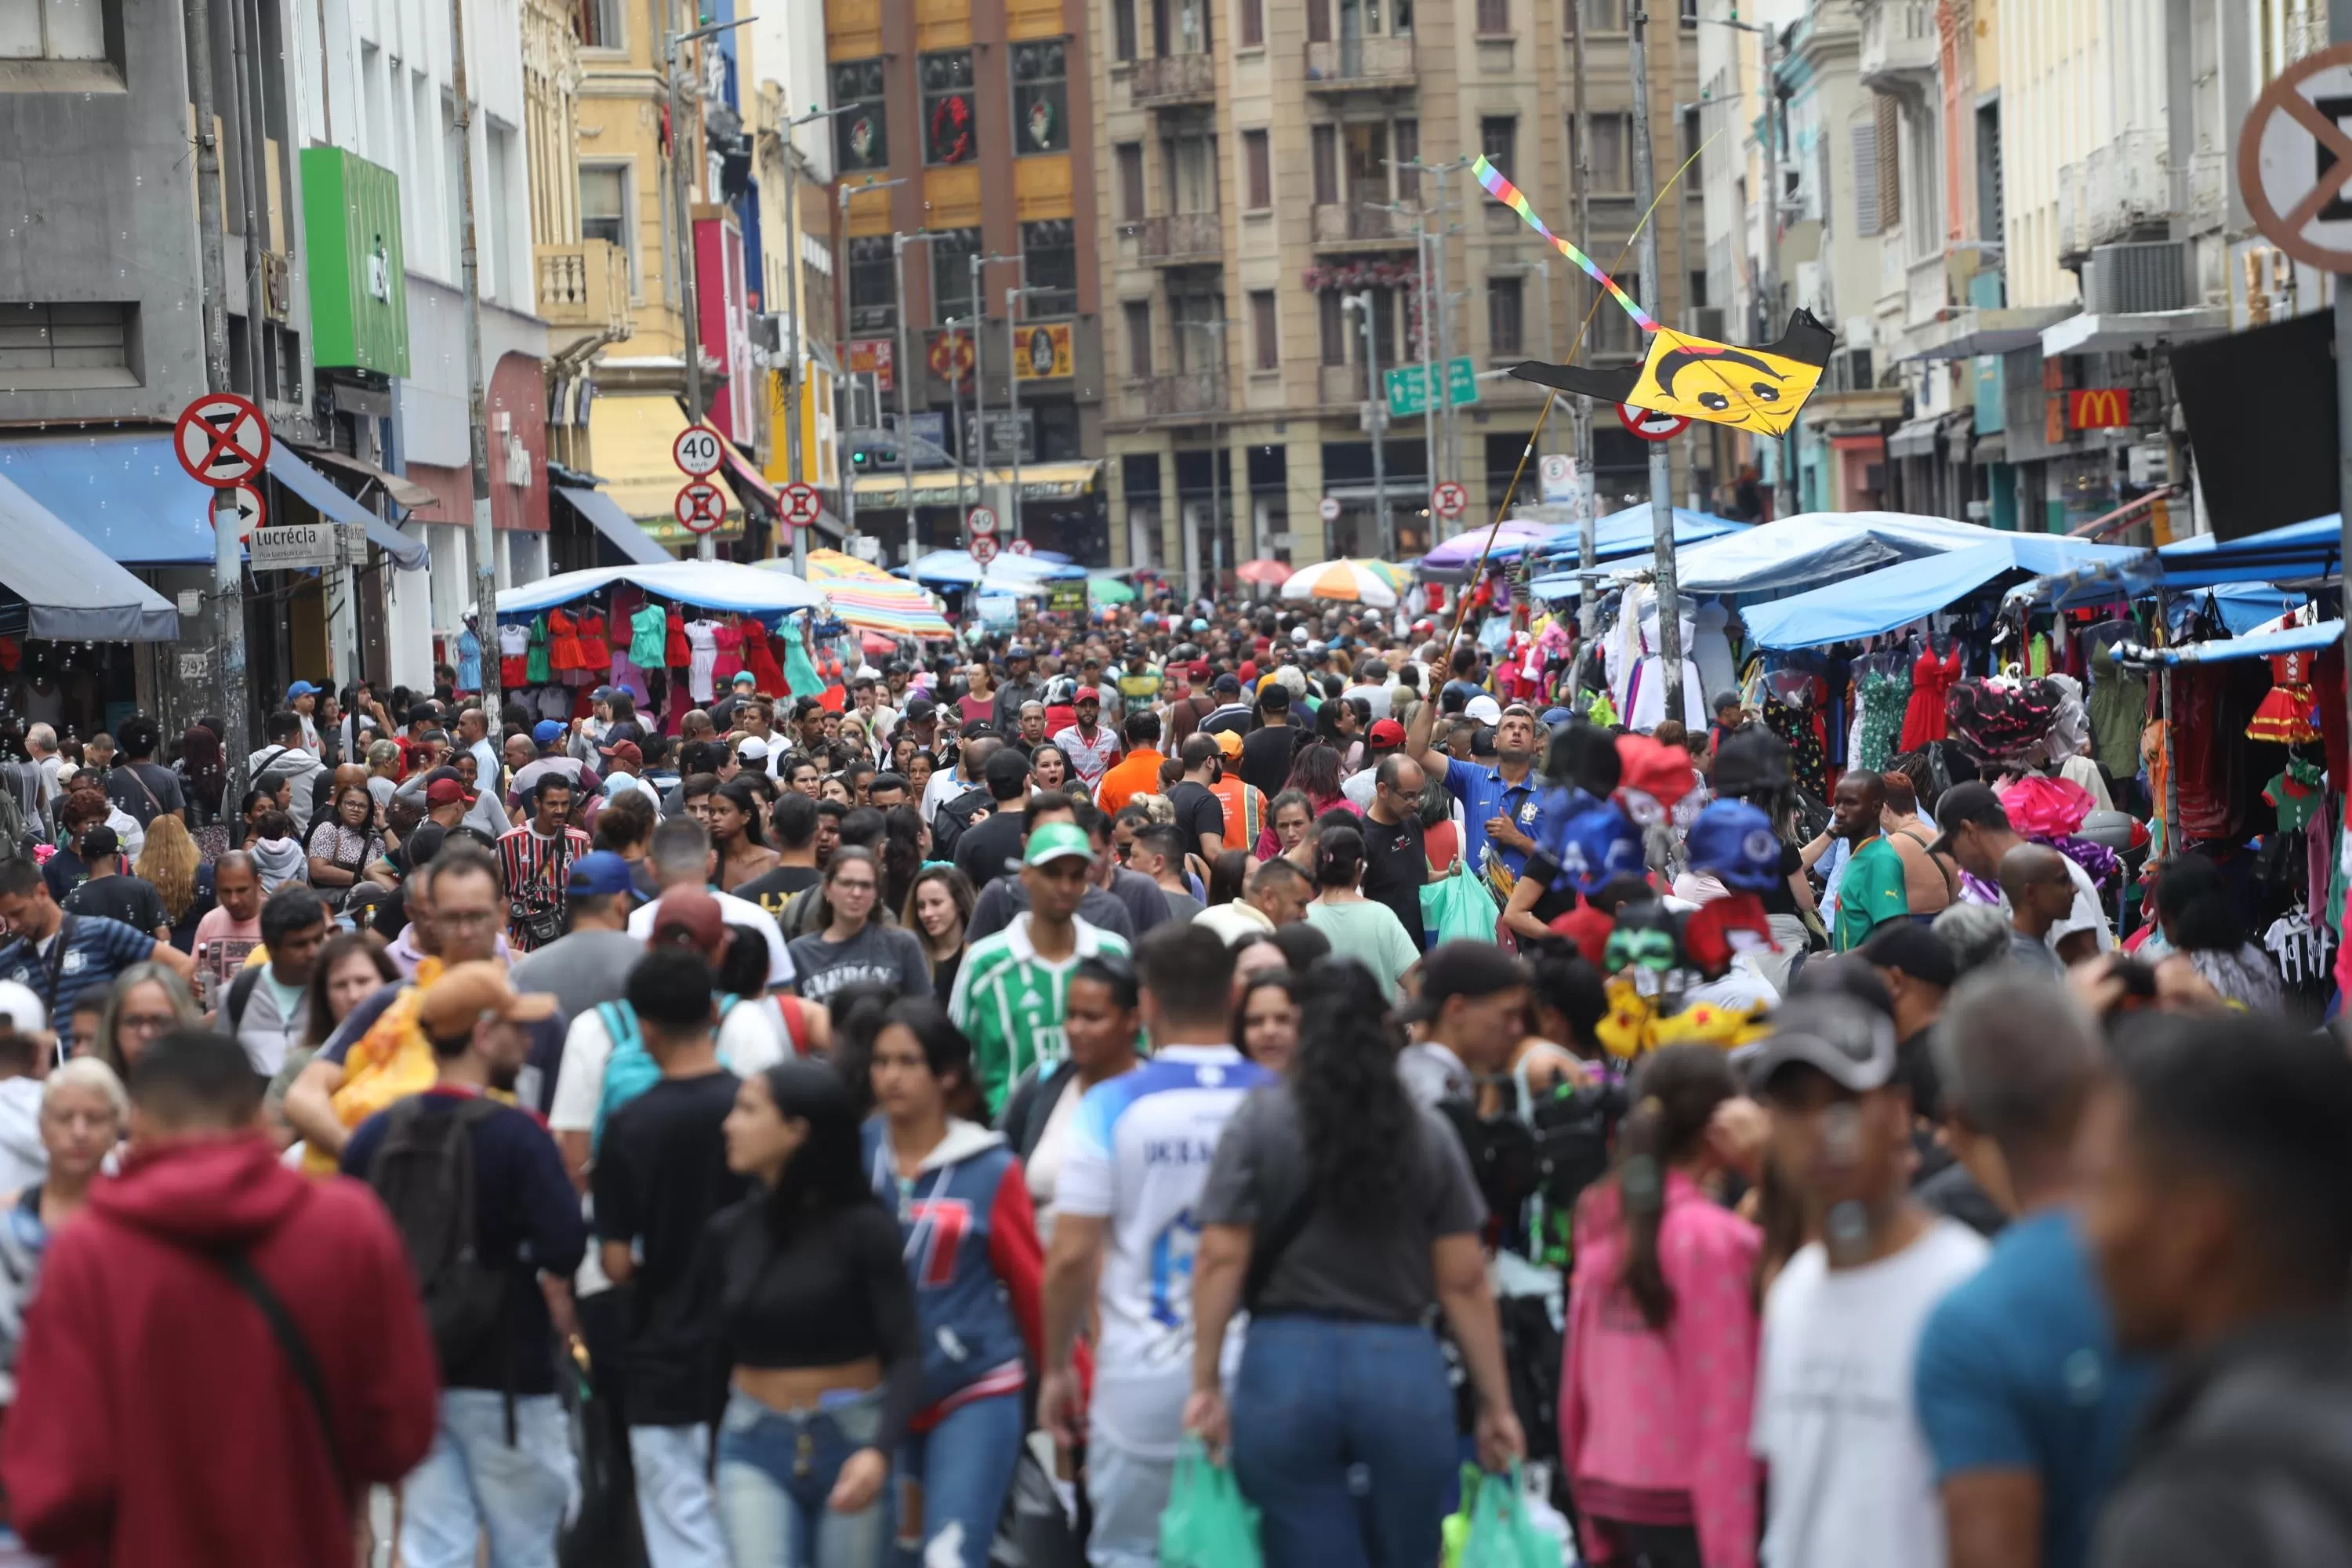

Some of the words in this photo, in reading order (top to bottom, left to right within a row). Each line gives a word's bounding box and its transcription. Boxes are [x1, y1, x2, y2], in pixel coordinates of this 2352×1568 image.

[682, 437, 715, 459] 40
[971, 514, 992, 526] 40
[256, 527, 316, 546] Lucrécia
